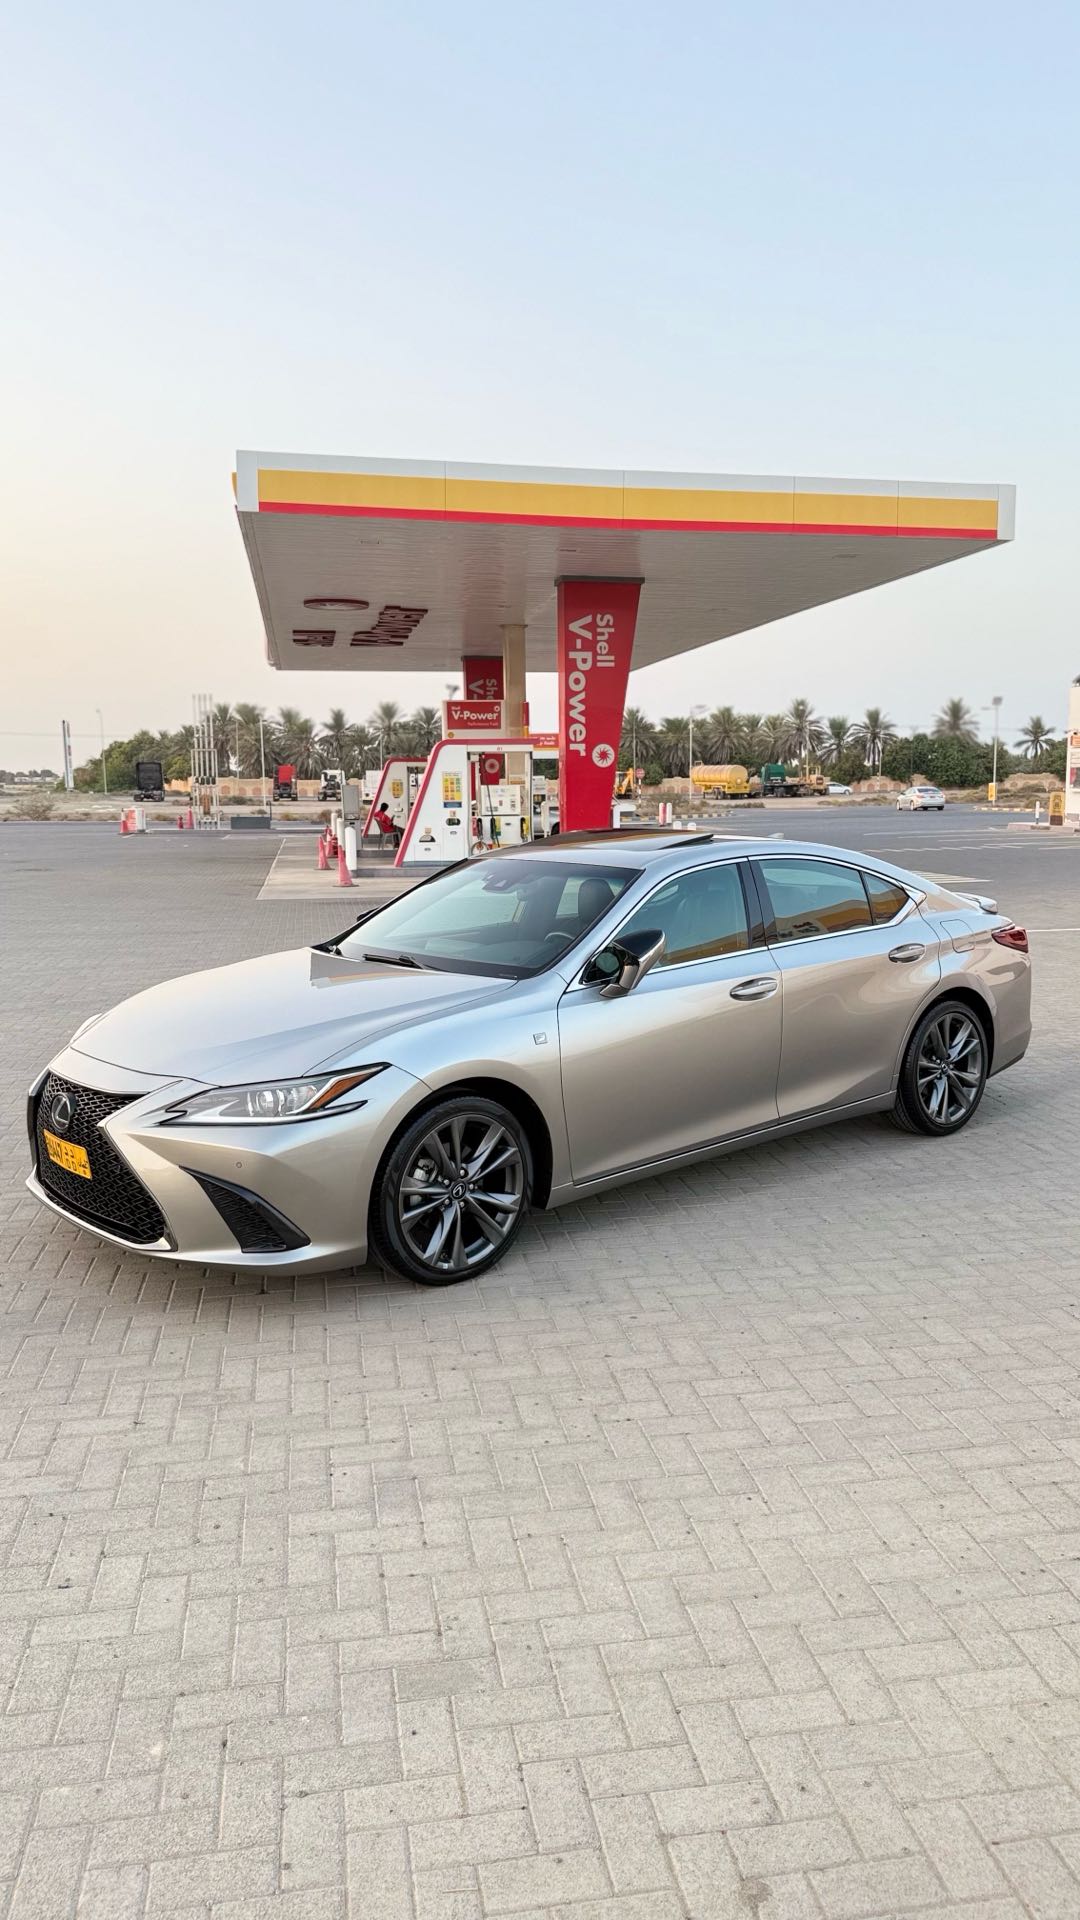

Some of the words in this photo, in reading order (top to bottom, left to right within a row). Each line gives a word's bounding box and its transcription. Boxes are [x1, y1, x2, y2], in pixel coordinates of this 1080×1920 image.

[596, 613, 616, 668] Shell
[568, 614, 593, 757] V-Power
[451, 710, 499, 720] V-Power
